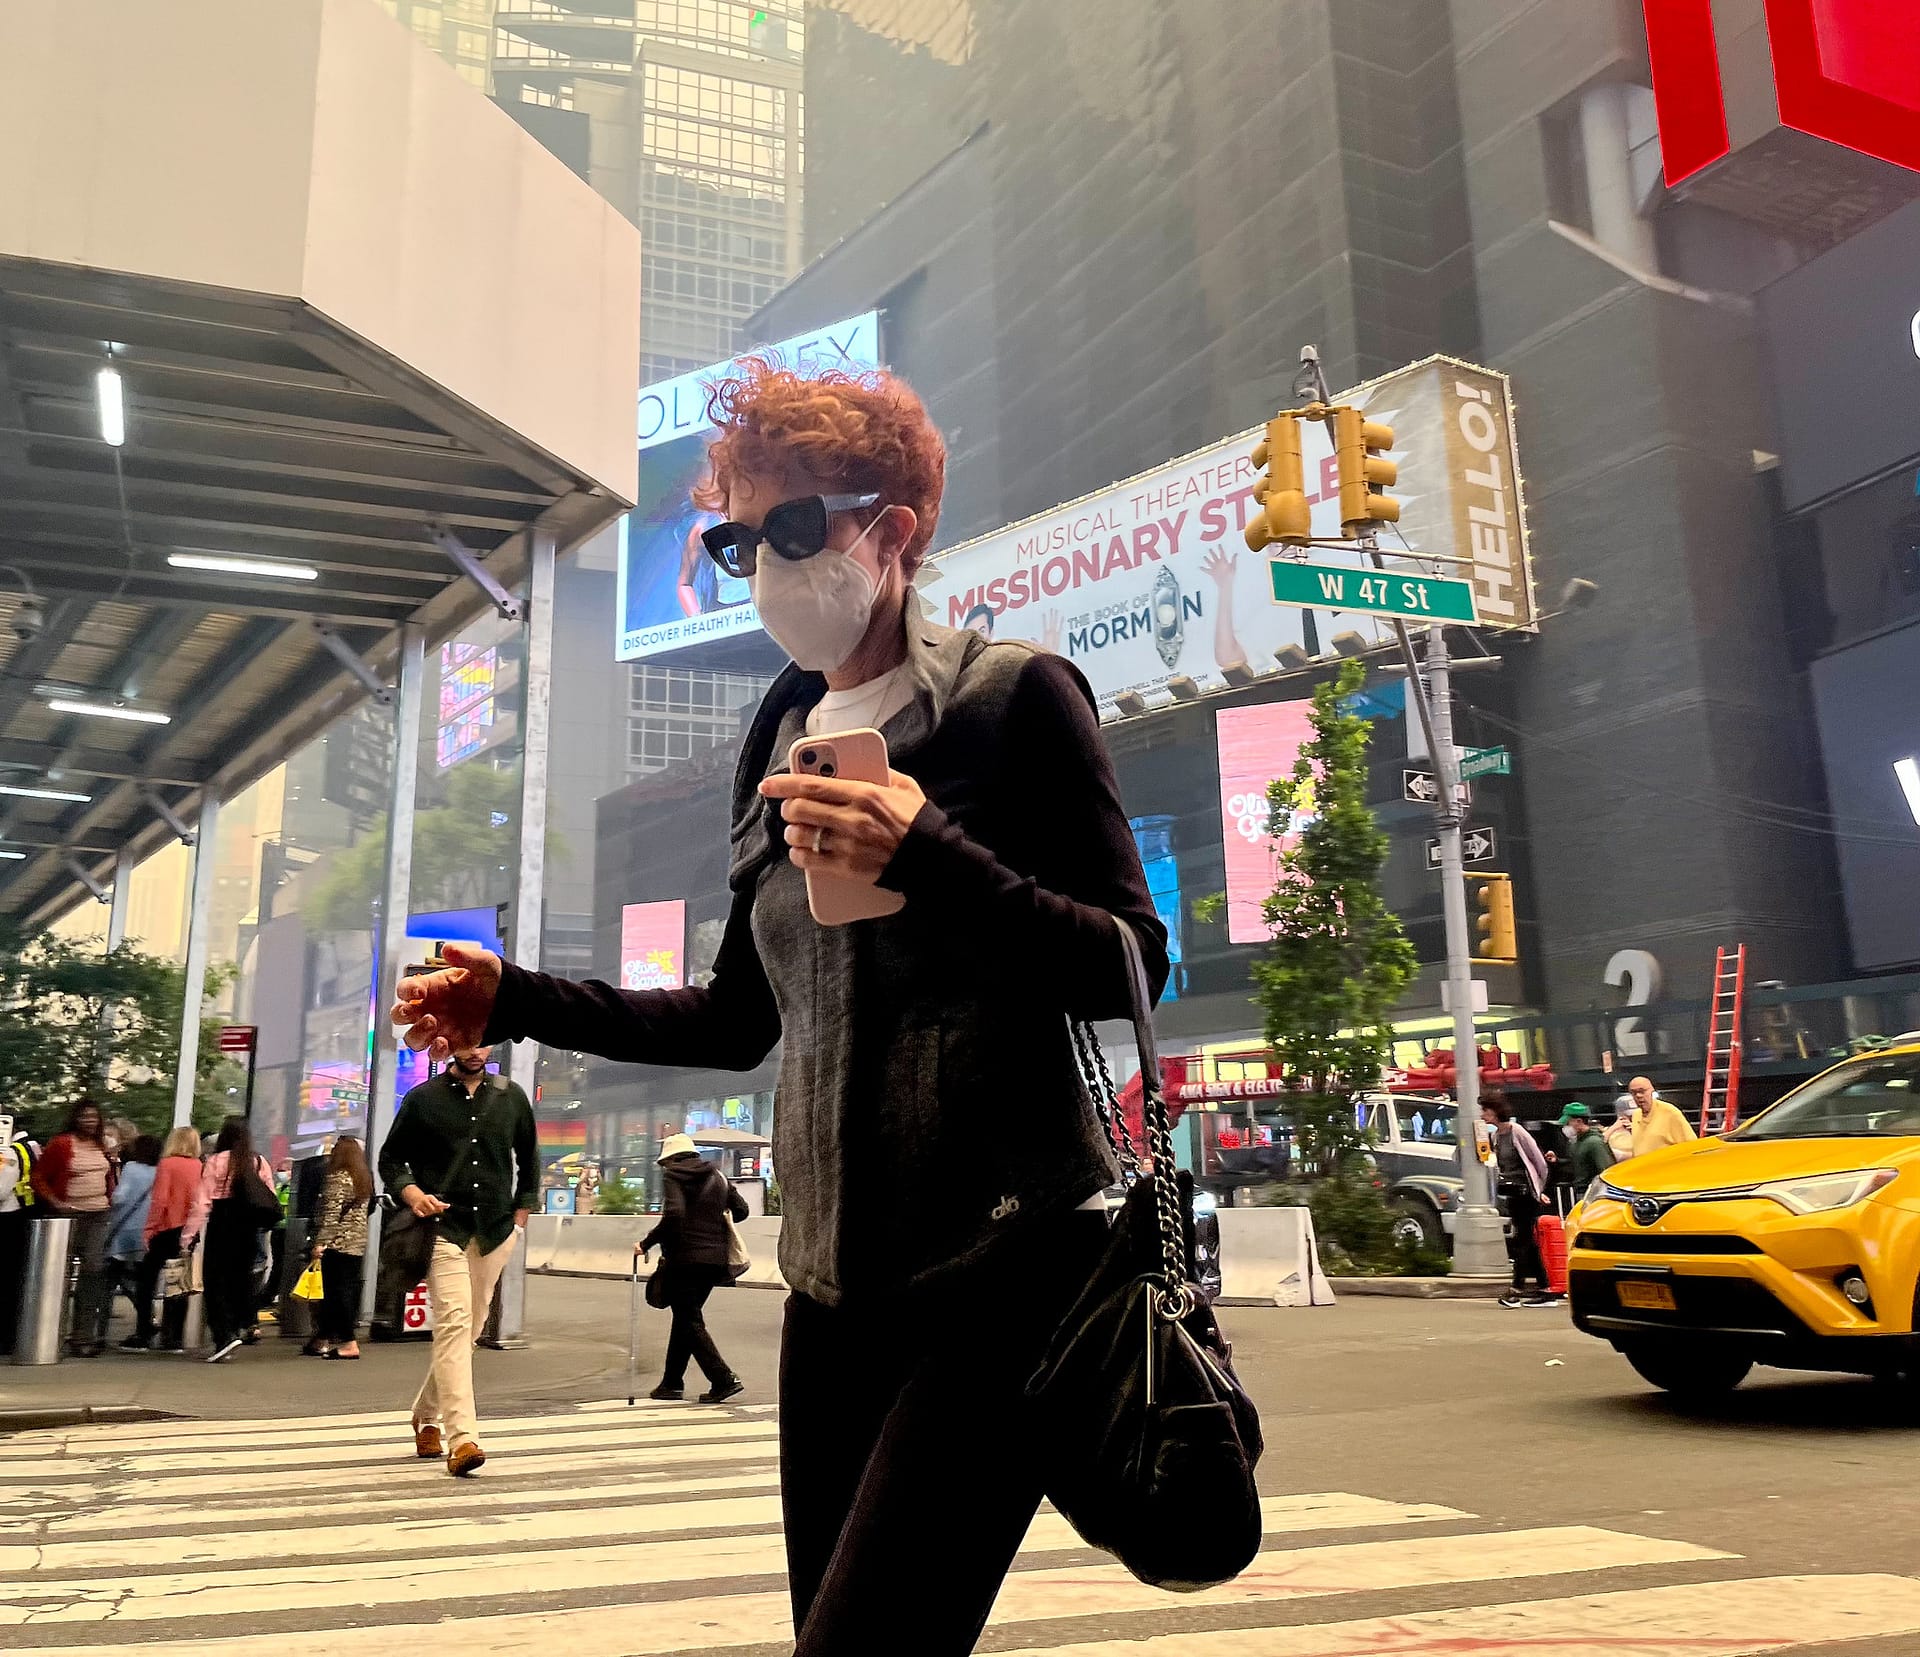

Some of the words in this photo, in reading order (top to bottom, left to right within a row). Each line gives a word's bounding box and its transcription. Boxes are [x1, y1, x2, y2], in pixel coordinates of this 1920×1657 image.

[1455, 381, 1514, 616] HELLO!
[948, 509, 1189, 628] MISSIONARY
[1199, 455, 1339, 542] STE
[1016, 508, 1122, 564] MUSICAL
[1067, 613, 1090, 629] THE
[1094, 600, 1129, 622] BOOK
[1132, 593, 1150, 609] OF
[1318, 572, 1344, 601] W
[1359, 580, 1388, 606] 47
[1401, 582, 1431, 611] St
[624, 627, 680, 650] DISCOVER
[683, 615, 732, 637] HEALTHY
[735, 610, 759, 625] HAI
[624, 960, 659, 975] Olive
[629, 973, 677, 988] Garden
[1604, 949, 1660, 1057] 2
